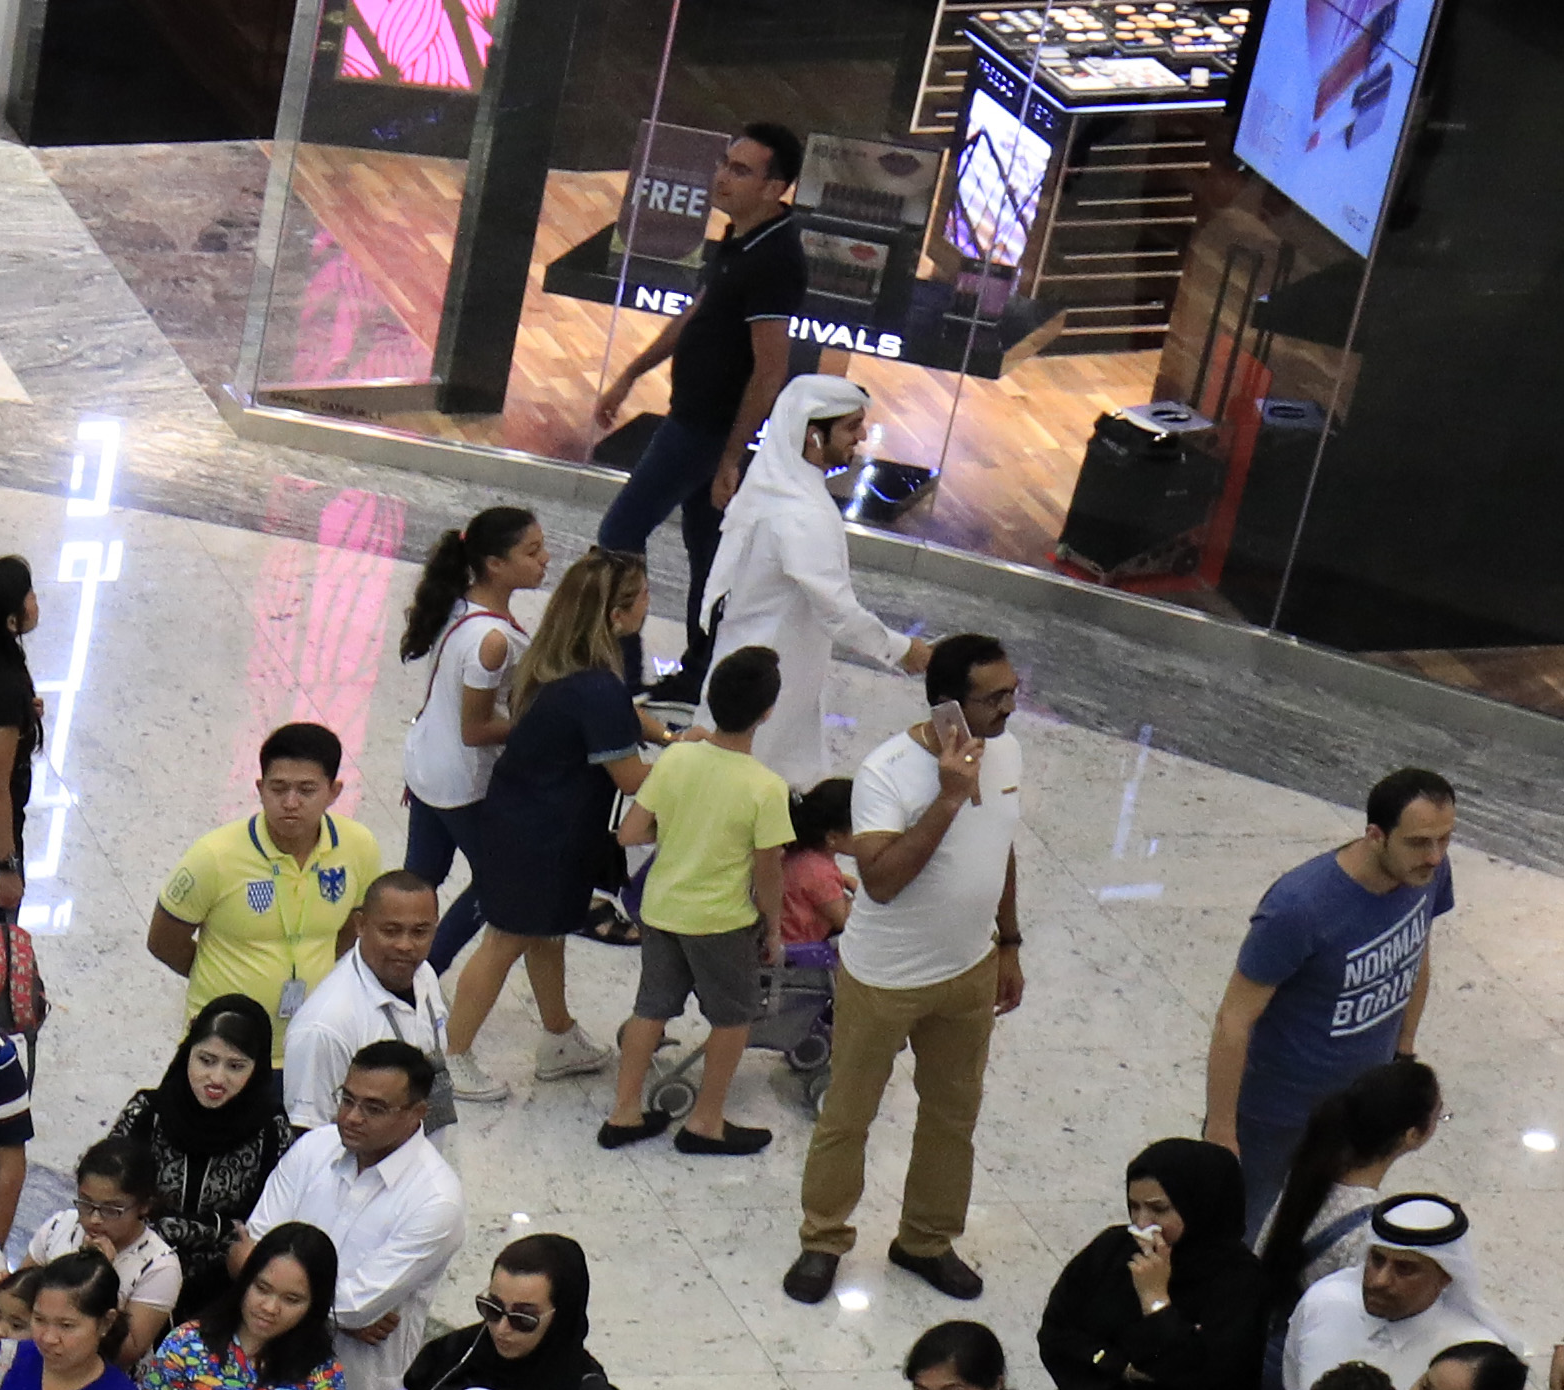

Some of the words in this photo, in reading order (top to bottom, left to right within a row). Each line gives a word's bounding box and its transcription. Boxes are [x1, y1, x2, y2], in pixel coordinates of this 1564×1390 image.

[631, 177, 708, 218] FREE
[636, 286, 693, 315] NE
[788, 316, 903, 357] RIVALS
[1331, 964, 1419, 1027] BORIN
